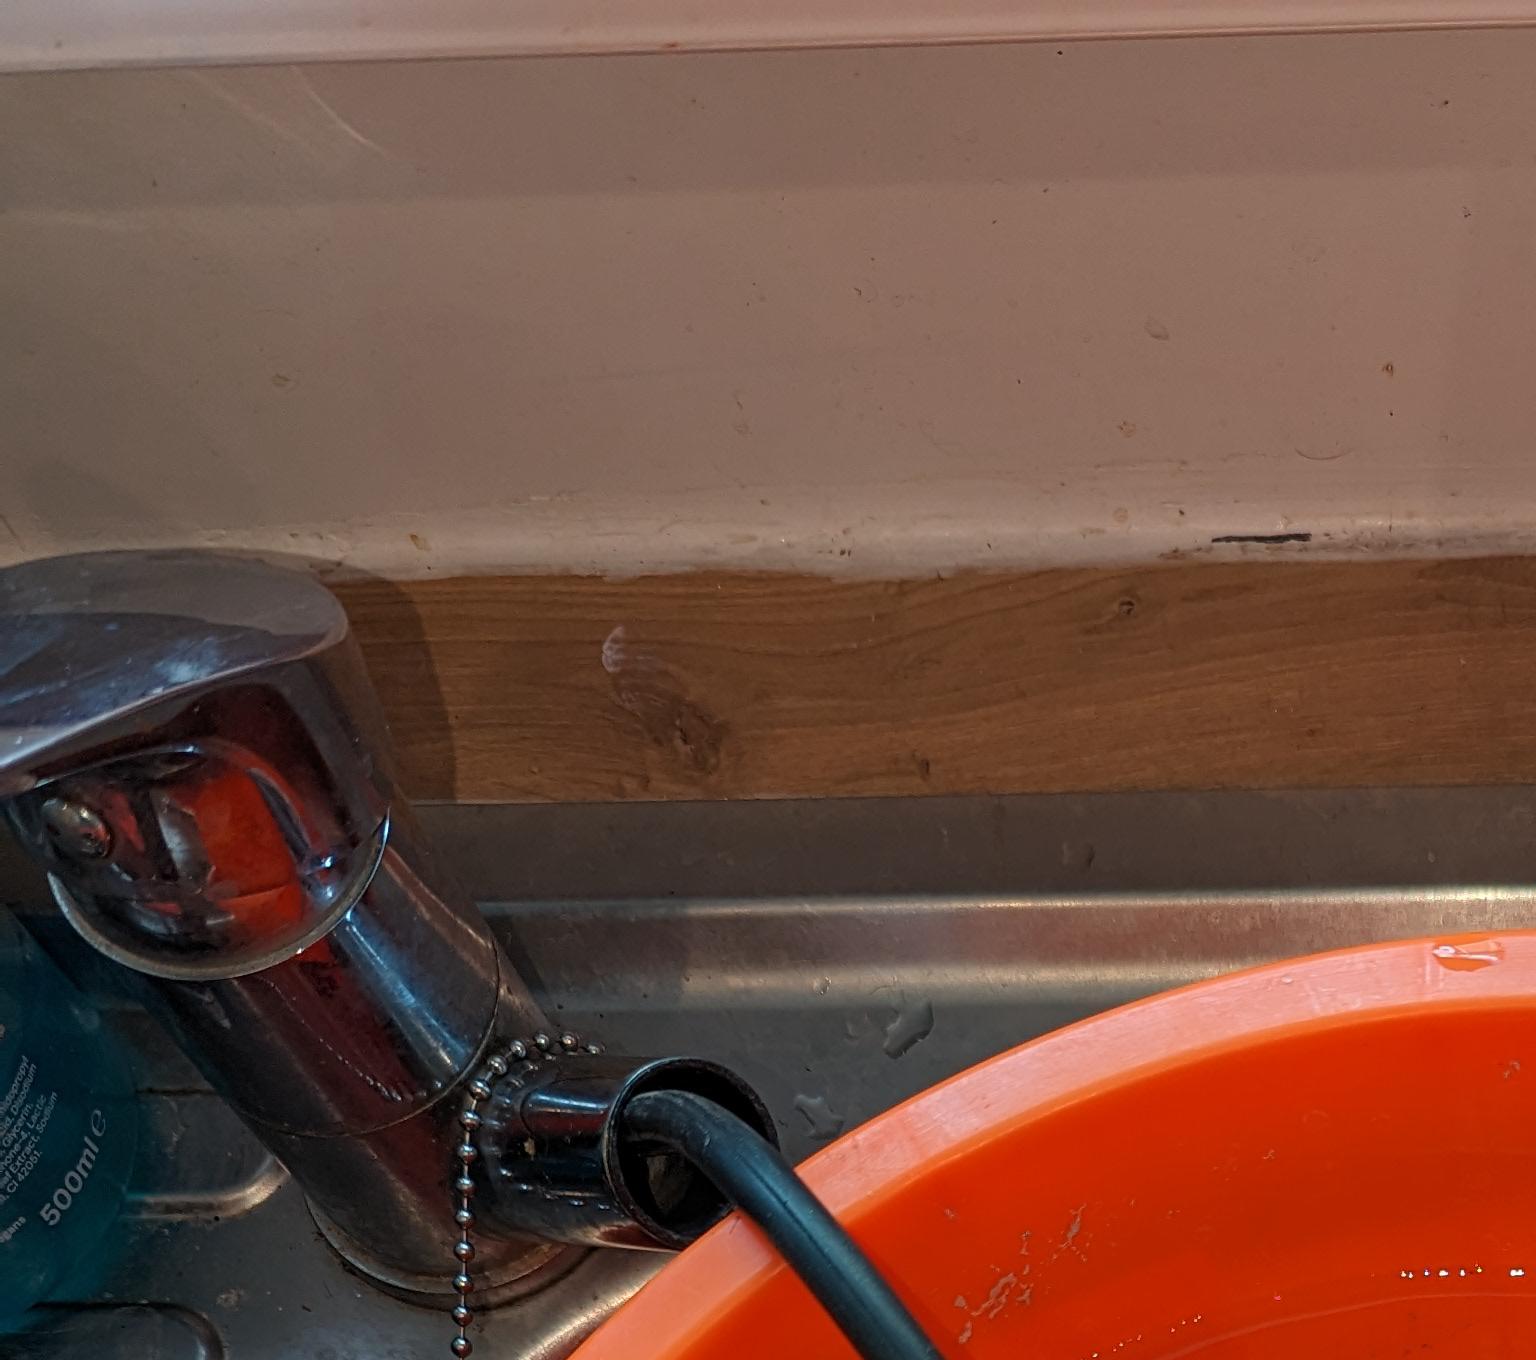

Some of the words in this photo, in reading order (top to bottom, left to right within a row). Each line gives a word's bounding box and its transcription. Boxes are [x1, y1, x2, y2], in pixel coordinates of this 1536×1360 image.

[27, 1095, 46, 1128] Lactic
[36, 1092, 58, 1133] Sodium
[40, 1136, 99, 1226] 500ml
